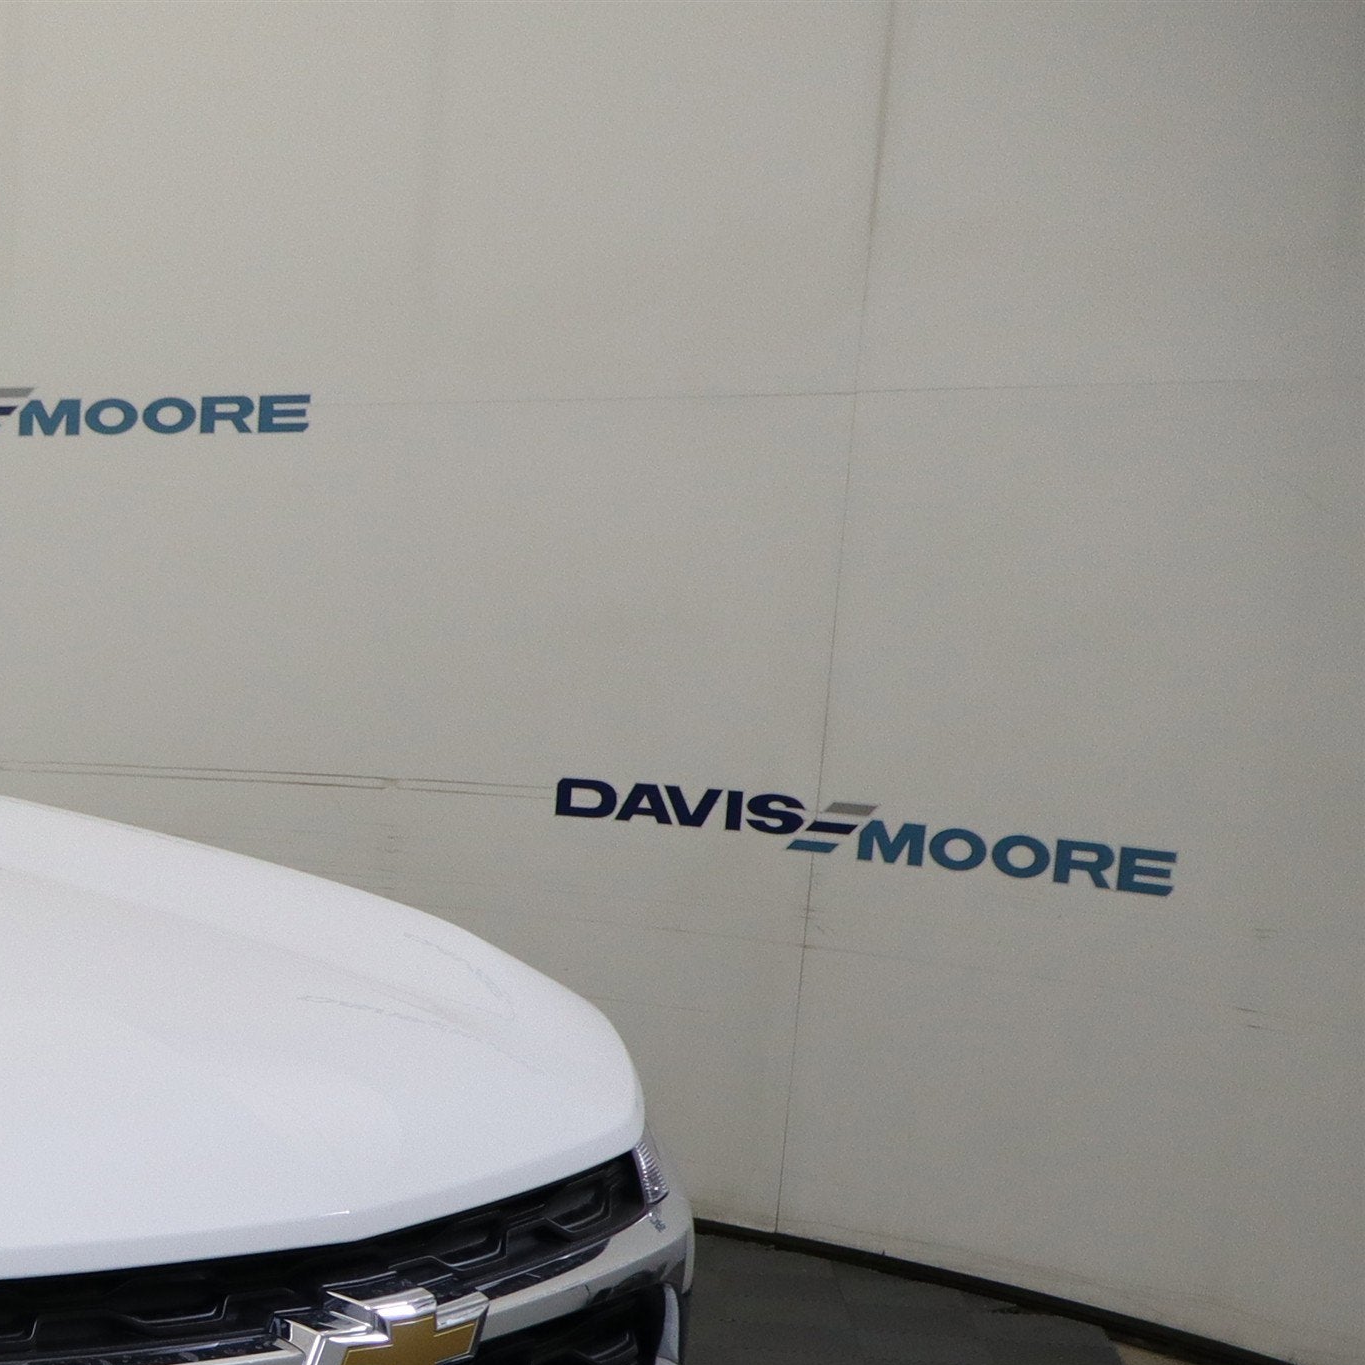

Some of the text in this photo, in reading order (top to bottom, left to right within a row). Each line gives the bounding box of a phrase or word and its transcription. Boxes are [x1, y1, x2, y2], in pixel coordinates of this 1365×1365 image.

[18, 393, 311, 437] MOORE
[554, 777, 1178, 898] DAVIS MOORE
